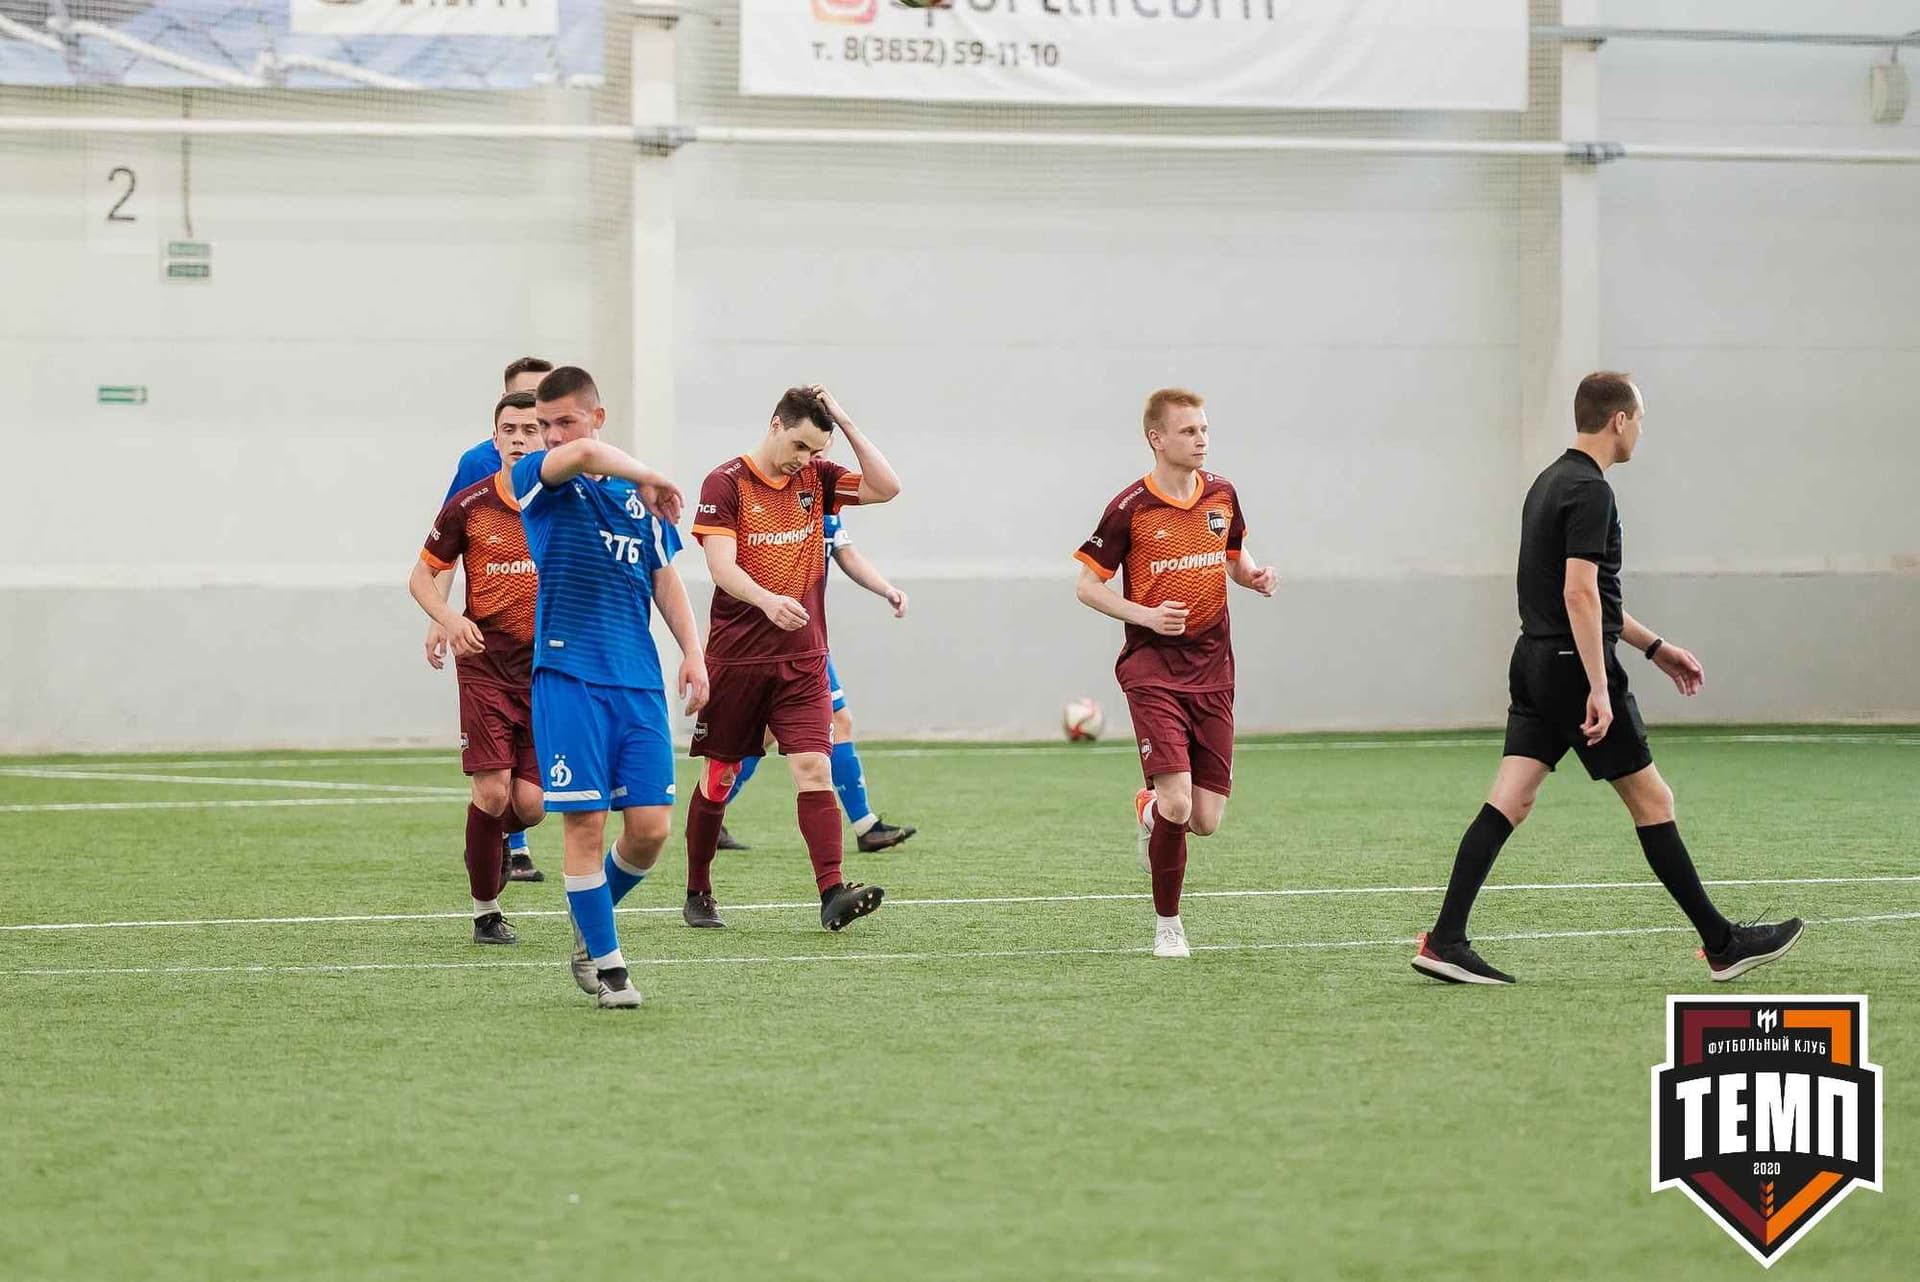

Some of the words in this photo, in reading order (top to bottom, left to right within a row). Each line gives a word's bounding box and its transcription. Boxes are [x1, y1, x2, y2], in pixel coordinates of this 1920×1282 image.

[844, 36, 945, 67] 8(3852)
[953, 40, 1059, 67] 59-11-10
[108, 167, 136, 221] 2
